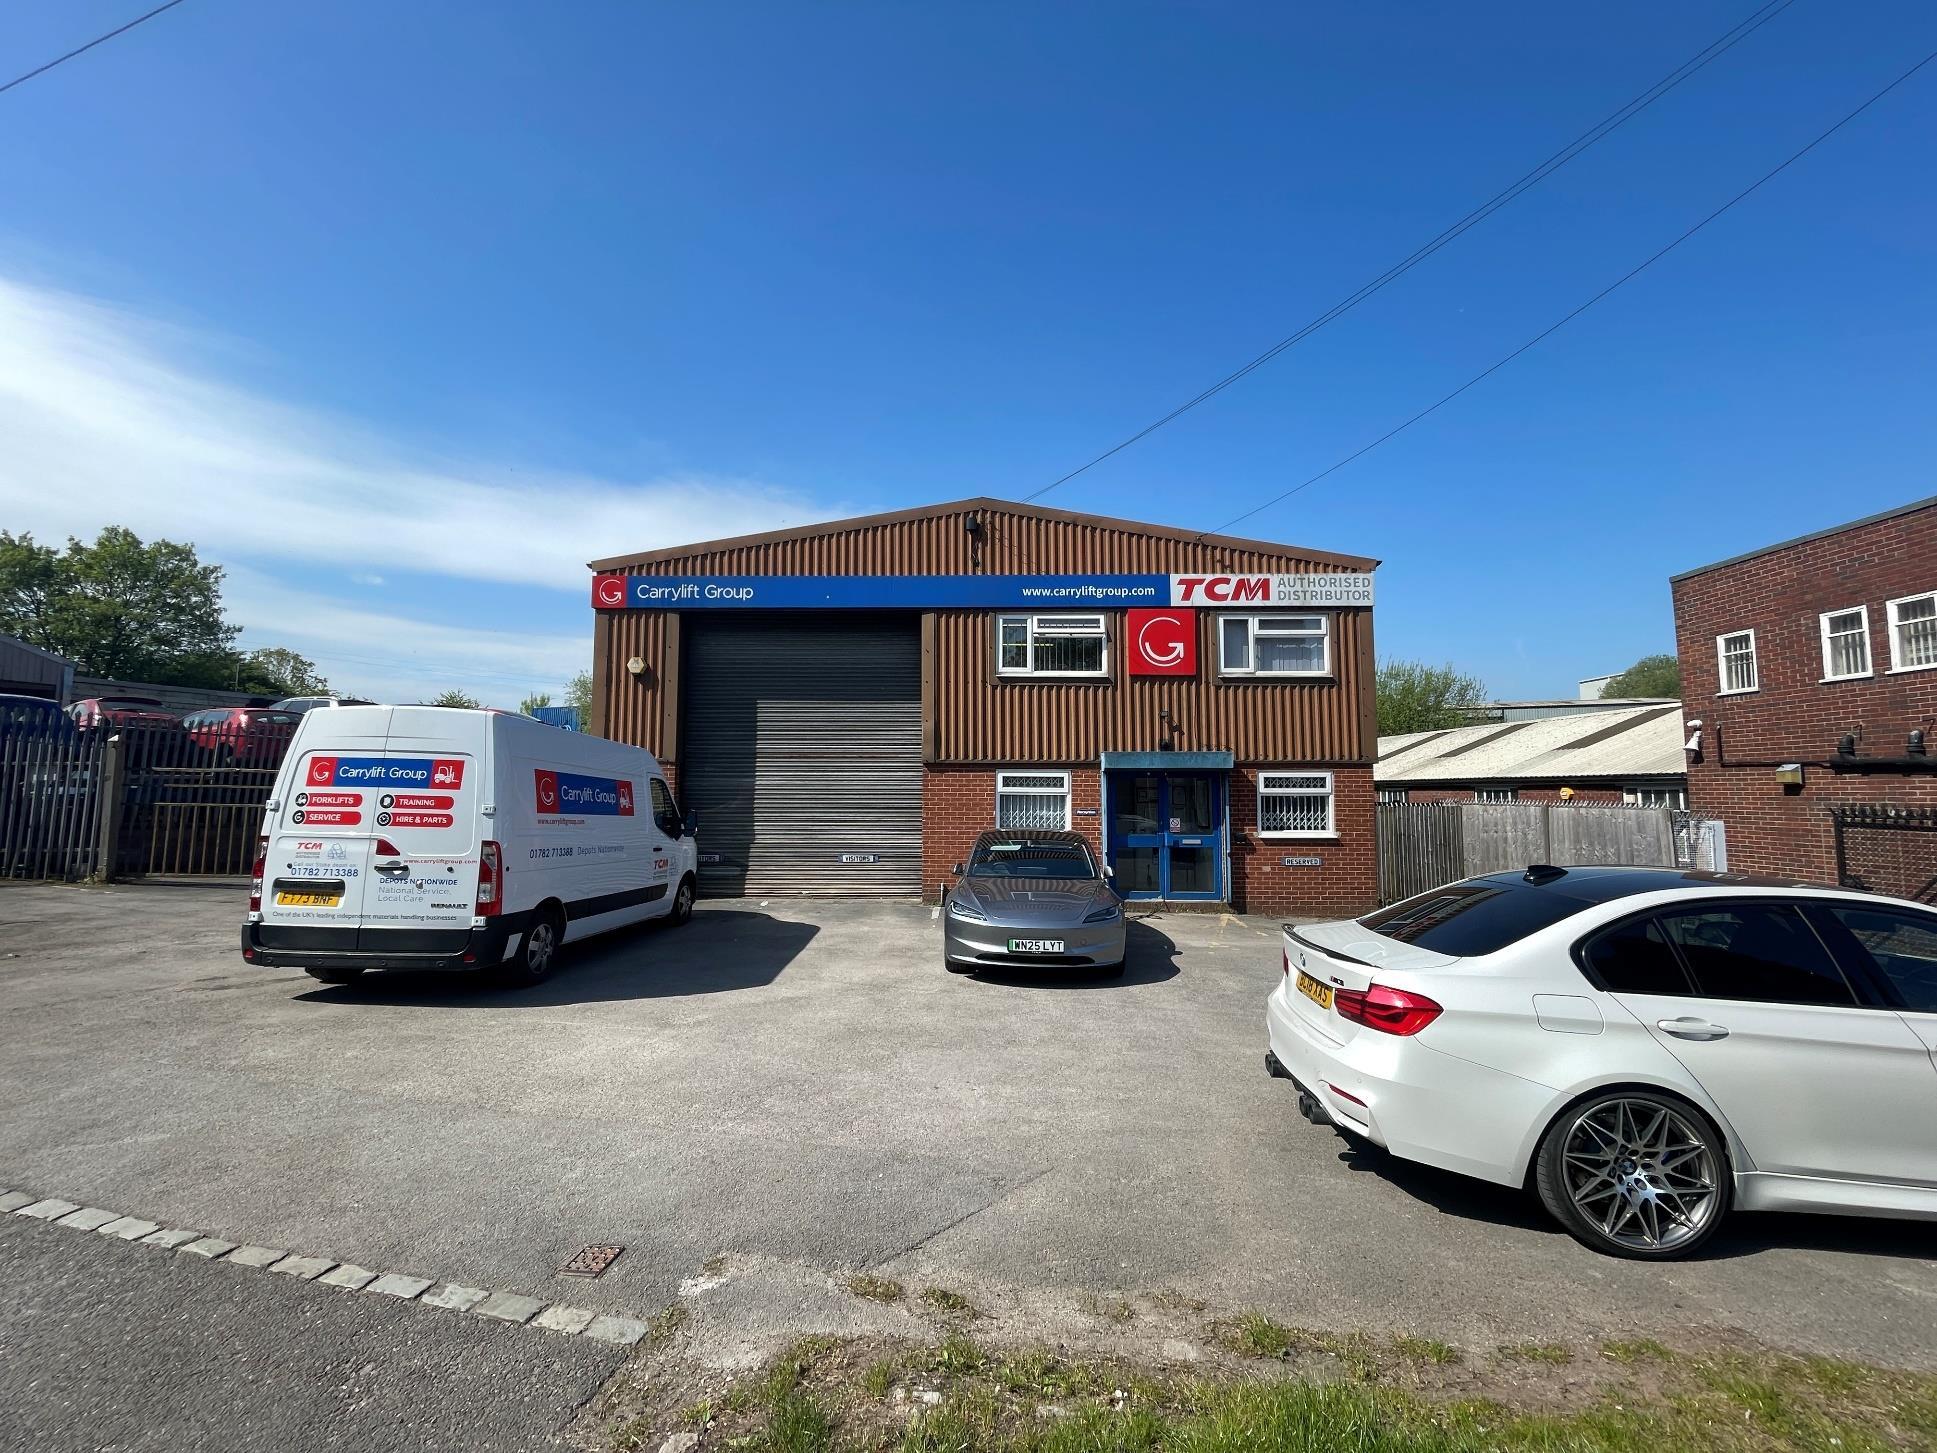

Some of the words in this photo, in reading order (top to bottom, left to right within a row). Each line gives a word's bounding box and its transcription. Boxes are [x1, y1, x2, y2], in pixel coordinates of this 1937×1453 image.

[1277, 577, 1371, 588] AUTHORISED
[637, 583, 699, 601] Carrylift
[704, 584, 754, 600] Group
[1022, 585, 1155, 598] www.carryliftgroup.com
[1176, 577, 1271, 602] TCM
[1278, 590, 1371, 601] DISTRIBUTOR
[339, 766, 386, 780] Carrylift
[389, 767, 427, 780] Group
[311, 796, 354, 804] FORKLIFTS
[561, 785, 593, 803] Carrylift
[594, 788, 616, 805] Group
[399, 798, 435, 806] TRAINING
[309, 813, 341, 821] SERVICE
[423, 816, 447, 824] PARTS
[297, 842, 323, 850] TCM
[529, 848, 550, 859] 01782
[291, 867, 320, 876] 01782
[322, 868, 359, 877] 713388
[379, 877, 408, 885] DEPOTS
[378, 886, 414, 894] National
[1014, 940, 1041, 951] WN25
[1043, 941, 1063, 951] LYT
